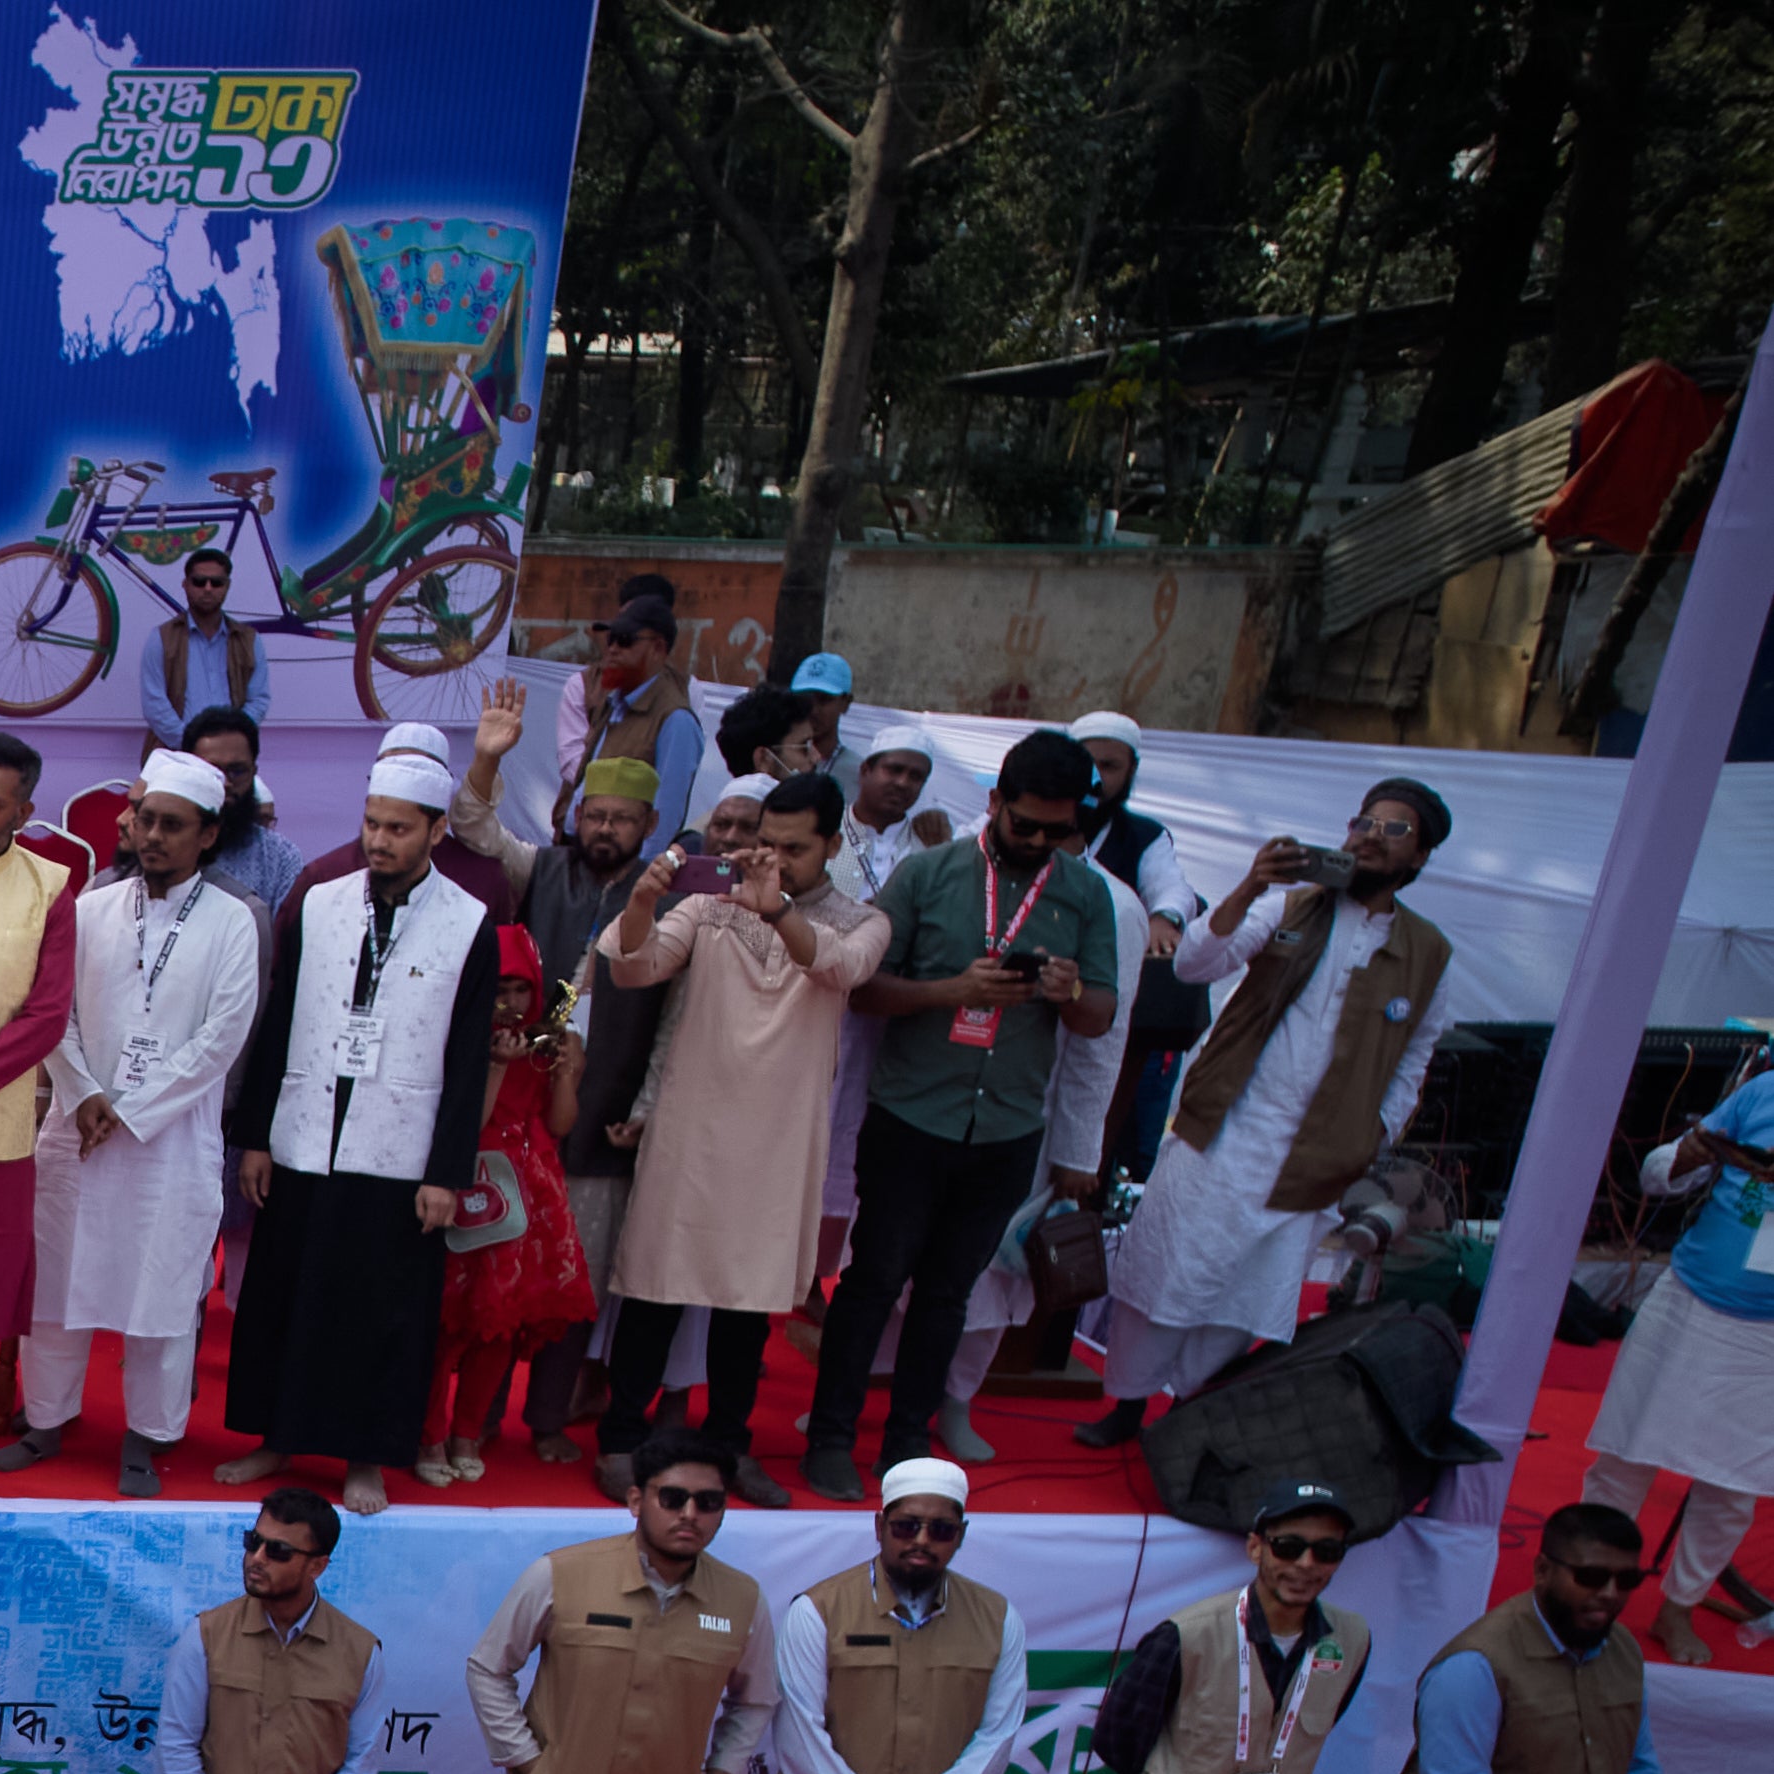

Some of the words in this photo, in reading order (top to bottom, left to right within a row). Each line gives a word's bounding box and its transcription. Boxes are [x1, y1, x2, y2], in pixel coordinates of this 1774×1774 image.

[108, 76, 209, 127] সমৃদ্ধ
[210, 75, 355, 140] ঢাকা
[62, 149, 194, 202] নিরাপদ
[99, 116, 201, 167] উন্নত
[194, 136, 338, 204] ১৩
